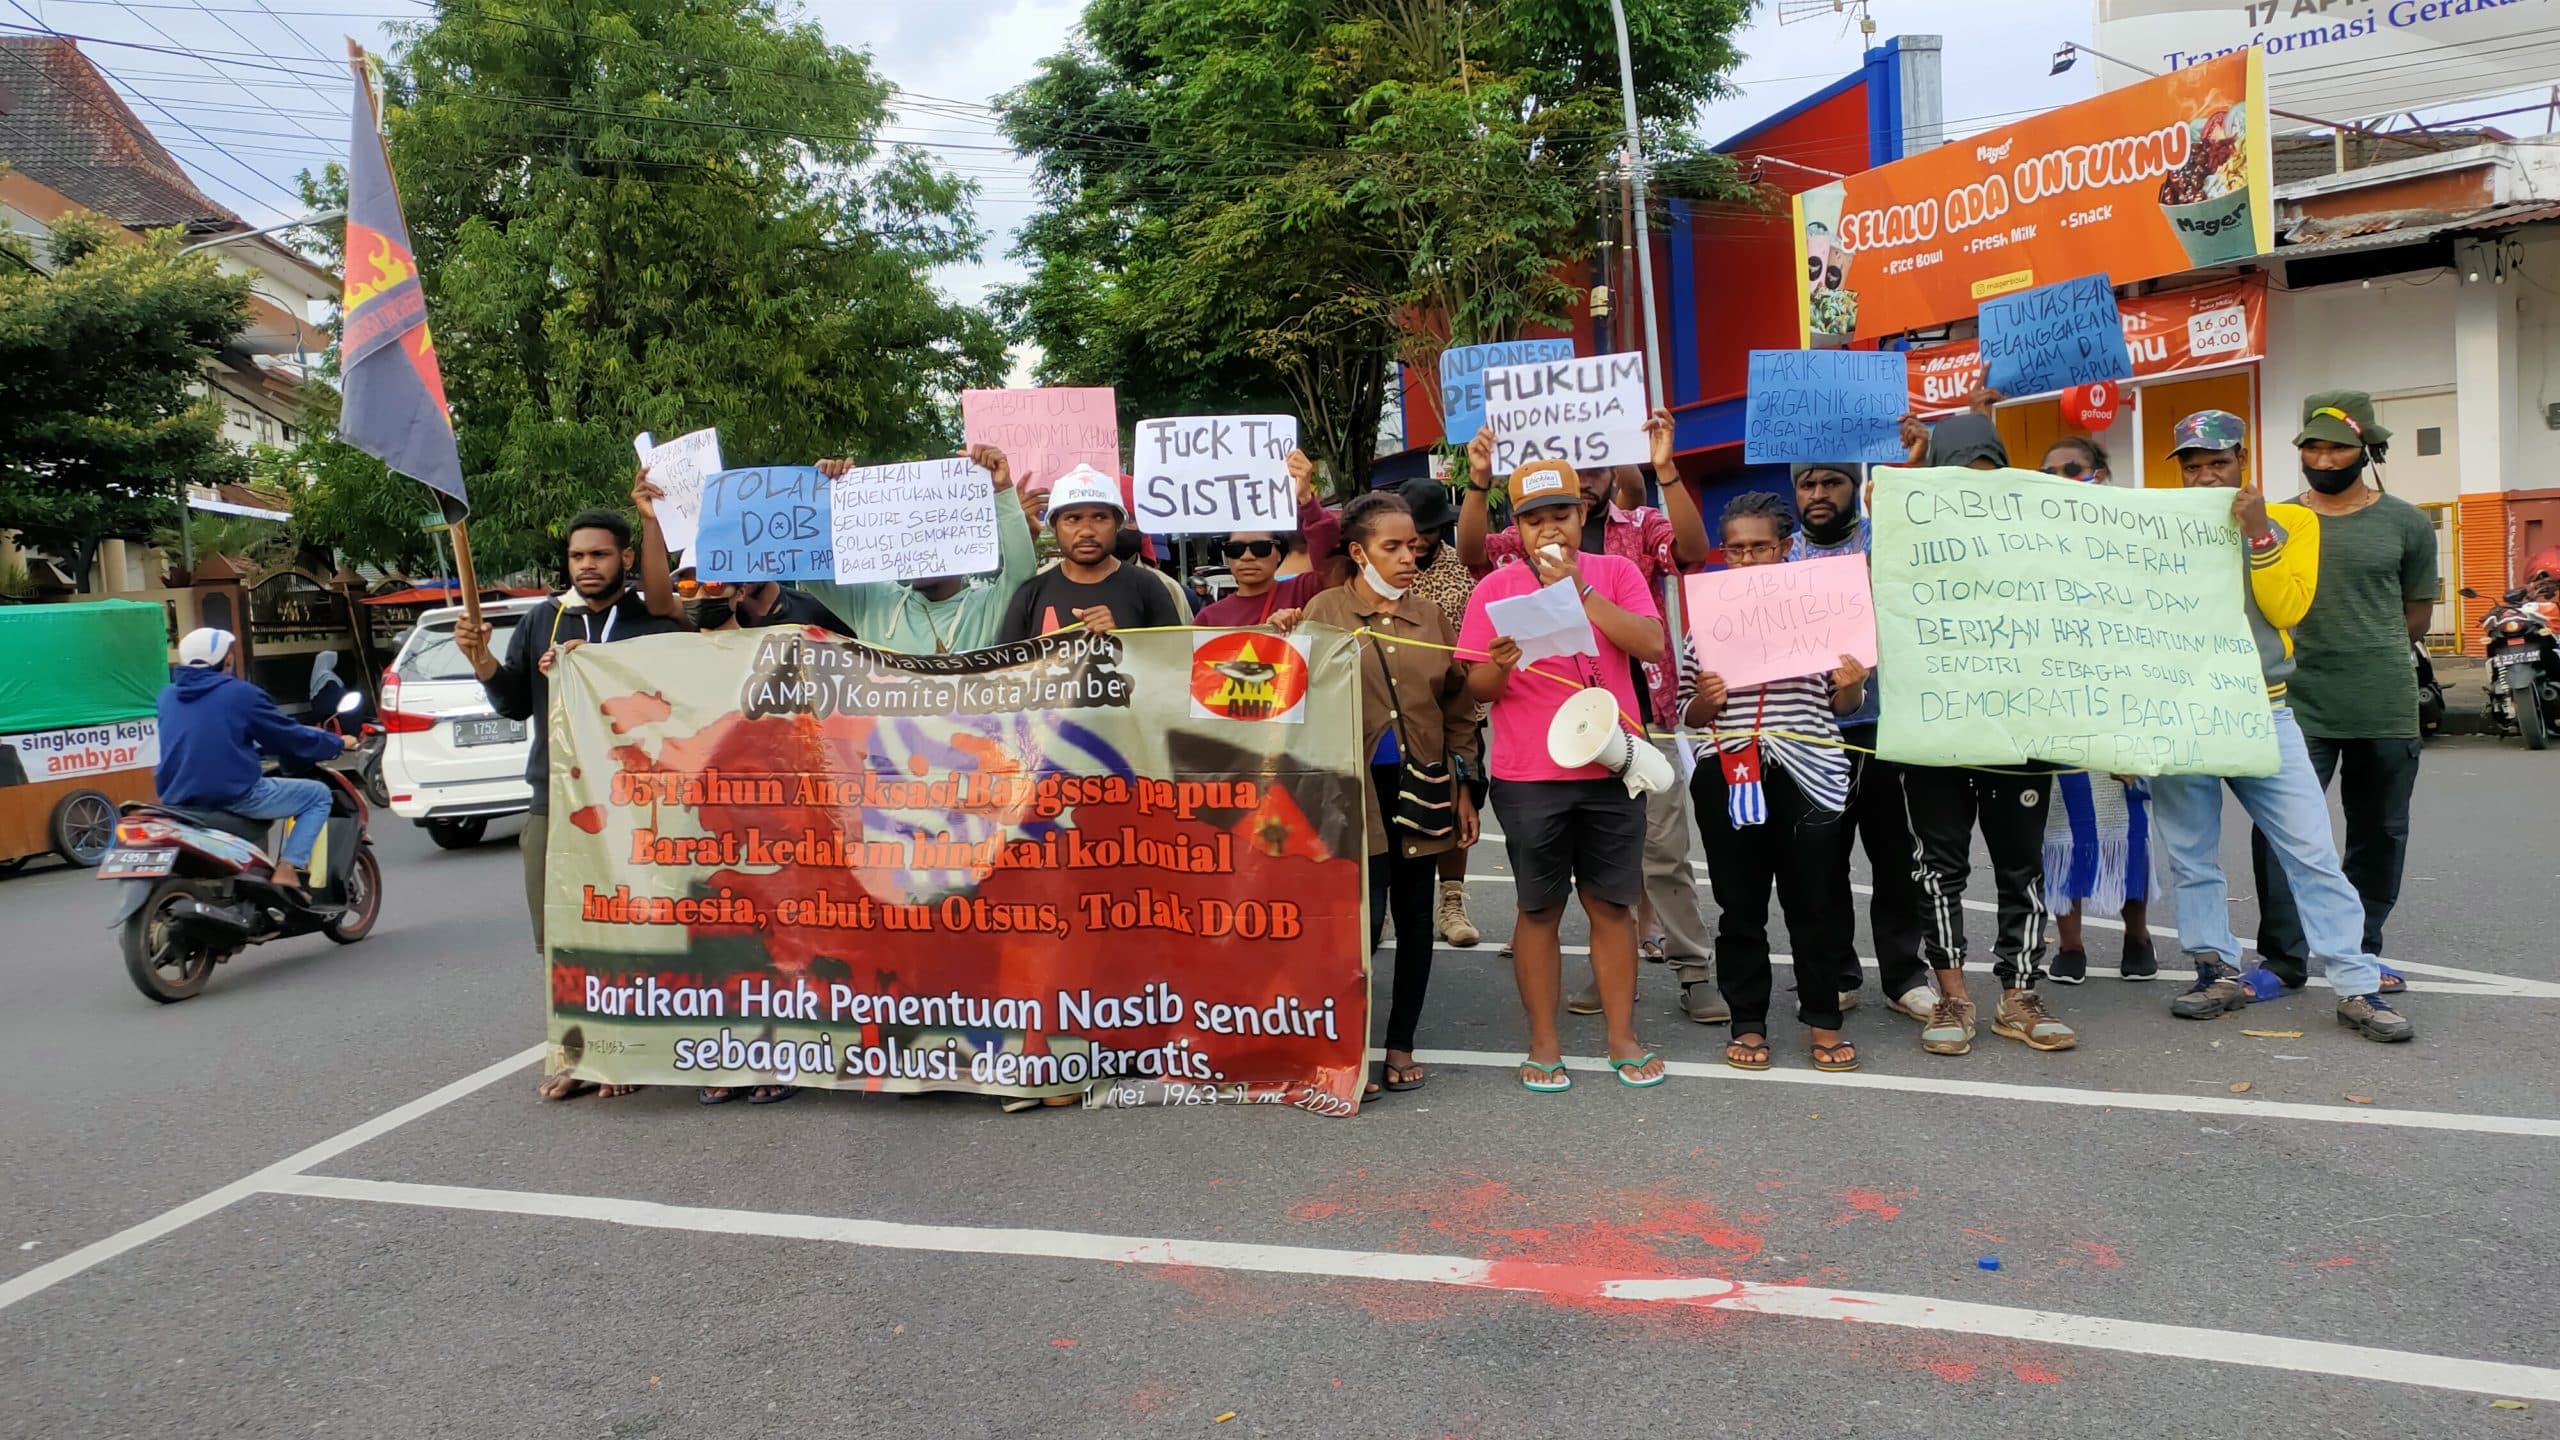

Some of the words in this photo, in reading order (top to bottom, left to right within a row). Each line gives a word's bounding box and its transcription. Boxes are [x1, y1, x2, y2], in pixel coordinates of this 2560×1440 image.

[2245, 0, 2279, 27] 17
[1977, 137, 2014, 164] Mager
[1840, 198, 1938, 254] SELALU
[1945, 174, 2009, 233] ADA
[2014, 120, 2192, 204] UNTUKMU
[2069, 204, 2113, 229] Snack
[2176, 203, 2246, 236] Mager
[1971, 233, 2009, 254] Fresh
[1890, 257, 1915, 275] Rice
[1916, 249, 1943, 268] Bowl
[1985, 279, 2114, 334] TUNTASKAN
[2195, 314, 2238, 332] 16.00
[1981, 305, 2117, 360] PELANGGARAN
[2197, 332, 2240, 348] 04.00
[1442, 343, 1574, 381] INDONESIA
[1484, 356, 1643, 402] HUKUM
[1756, 352, 1822, 383] TARIK
[1833, 352, 1903, 384] MILITER
[2018, 344, 2065, 383] HAM
[2070, 357, 2124, 386] PAPUA
[1490, 396, 1625, 433] INDONESIA
[1759, 388, 1849, 417] ORGANIK
[1868, 392, 1905, 415] NON
[2081, 408, 2112, 421] gofood
[1751, 419, 1833, 438] ORGANIK
[1496, 432, 1609, 471] RASIS
[706, 468, 832, 516] TOLAK
[835, 464, 921, 491] BERIKAN
[941, 460, 980, 485] HAK
[834, 485, 945, 510] MENENTUKAN
[947, 483, 989, 502] NASIB
[741, 505, 820, 546] DOB
[833, 512, 901, 532] SENDIRI
[907, 507, 996, 528] SEBAGAI
[1904, 490, 2024, 526] CABUT
[2040, 498, 2168, 541] OTONOMI
[2175, 516, 2240, 549] KHUSUS
[834, 534, 894, 554] SOLUSI
[901, 524, 992, 547] DEMOKRATIS
[1909, 537, 1966, 567] JILID
[1999, 533, 2072, 555] TOLAK
[2085, 535, 2187, 576] DAERAH
[709, 550, 733, 572] DI
[746, 549, 803, 575] WEST
[841, 556, 876, 574] BAGI
[880, 549, 939, 571] BANGSA
[954, 541, 996, 556] WEST
[896, 559, 948, 578] PAPUA
[1718, 566, 1820, 602] CABUT
[1912, 578, 2048, 606] OTONOMI
[2056, 578, 2133, 605] BARU
[2146, 590, 2200, 612] DAN
[1712, 594, 1865, 642] OMNIBUS
[1760, 629, 1832, 665] LAW
[1916, 614, 2041, 650] BERIKAN
[2051, 618, 2094, 650] HAK
[2098, 620, 2205, 654] PENENTUAN
[2214, 633, 2254, 658] NASIB
[759, 641, 866, 669] Aliansi
[747, 677, 830, 712] (AMP)
[846, 679, 949, 708] Komite
[963, 678, 1022, 707] Kota
[1032, 671, 1129, 704] Jember
[1926, 655, 2022, 675] SENDIRI
[2040, 658, 2132, 682] SEBAGAI
[2141, 663, 2195, 687] SOLUSI
[2209, 671, 2258, 695] YANG
[1228, 699, 1273, 718] AMP
[1920, 684, 2109, 723] DEMOKRATIS
[2121, 693, 2183, 729] BAGI
[22, 728, 110, 752] singkong
[116, 721, 155, 741] keju
[473, 721, 498, 736] 1752
[47, 746, 137, 772] ambyar
[2011, 734, 2098, 763] WEST
[2113, 735, 2205, 768] PAPUA
[661, 768, 785, 807] Tahun
[792, 769, 960, 810] Aneksasi
[965, 772, 1131, 818] Bangssa
[1137, 776, 1261, 820] papua
[629, 827, 740, 866] Barat
[745, 827, 905, 870] kedalam
[1066, 825, 1235, 874] kolonial
[582, 884, 768, 929] Indonesia,
[776, 889, 875, 927] cabut
[881, 900, 933, 931] uu
[940, 894, 1070, 940] Otsus,
[1080, 887, 1195, 935] Tolak
[1199, 897, 1303, 940] DOB
[584, 974, 725, 1018] Barikan
[740, 977, 818, 1020] Hak
[829, 982, 1042, 1032] Penentuan
[1057, 980, 1184, 1032] Nasib
[1194, 995, 1339, 1041] sendiri
[674, 1026, 835, 1081] sebagai
[845, 1033, 959, 1082] solusi
[971, 1037, 1226, 1087] demokratis.
